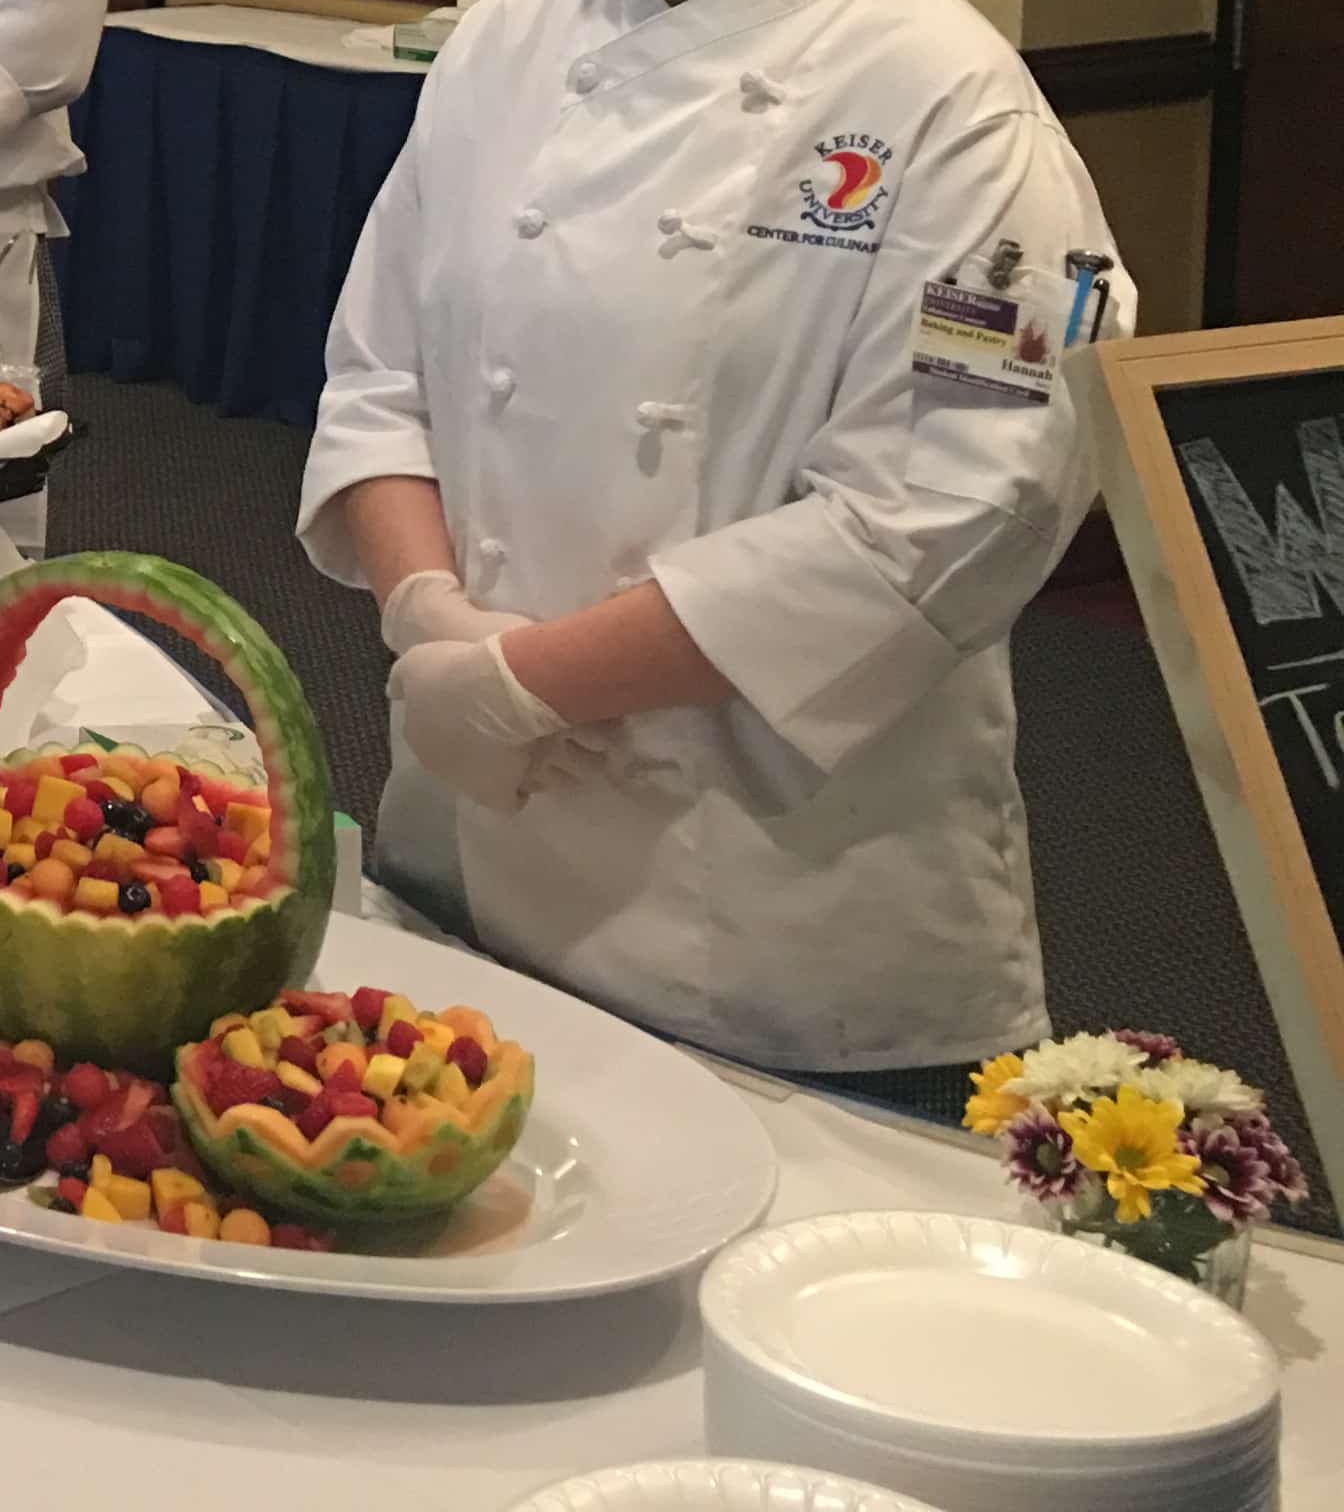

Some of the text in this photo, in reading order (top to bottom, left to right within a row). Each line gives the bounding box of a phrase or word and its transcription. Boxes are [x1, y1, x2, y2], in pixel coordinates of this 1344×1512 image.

[814, 134, 893, 166] KEISER
[799, 179, 889, 225] UNIVERSITY
[747, 225, 800, 243] CENTER
[825, 237, 880, 254] CULINAR
[926, 284, 977, 305] KEISER
[956, 327, 975, 339] and
[1001, 358, 1054, 381] Hannah
